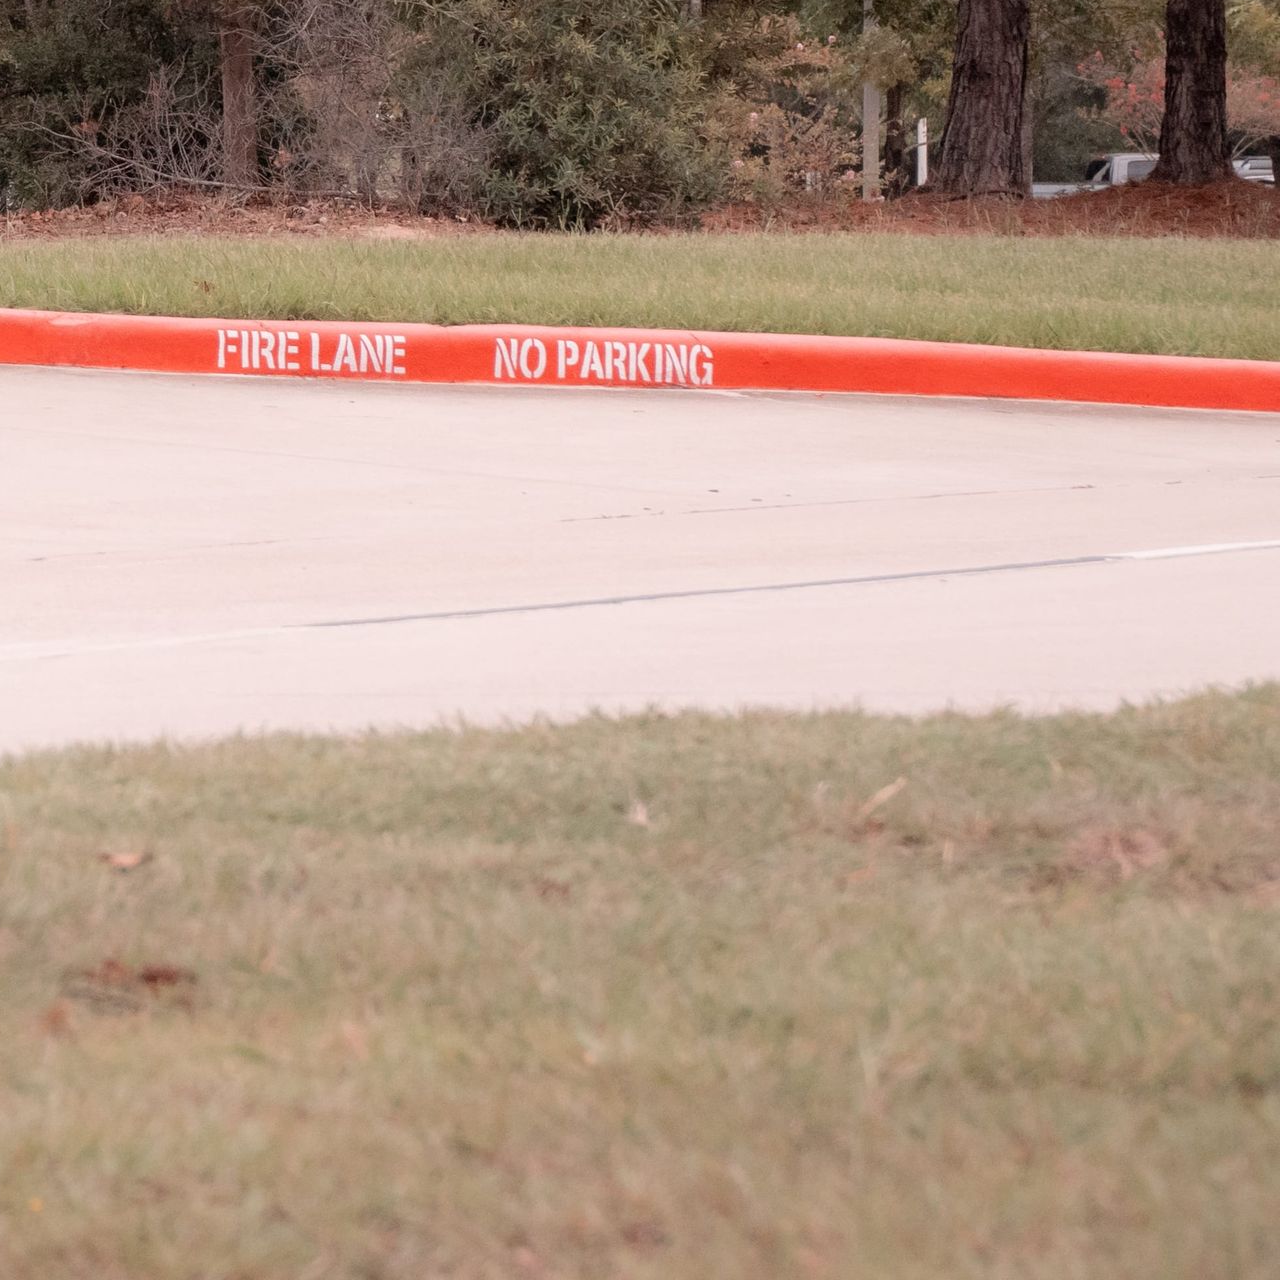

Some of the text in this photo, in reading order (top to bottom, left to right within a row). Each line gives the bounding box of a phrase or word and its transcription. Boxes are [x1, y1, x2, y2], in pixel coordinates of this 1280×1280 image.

[217, 328, 407, 376] FIRE LANE
[494, 337, 715, 386] NO PARKING
